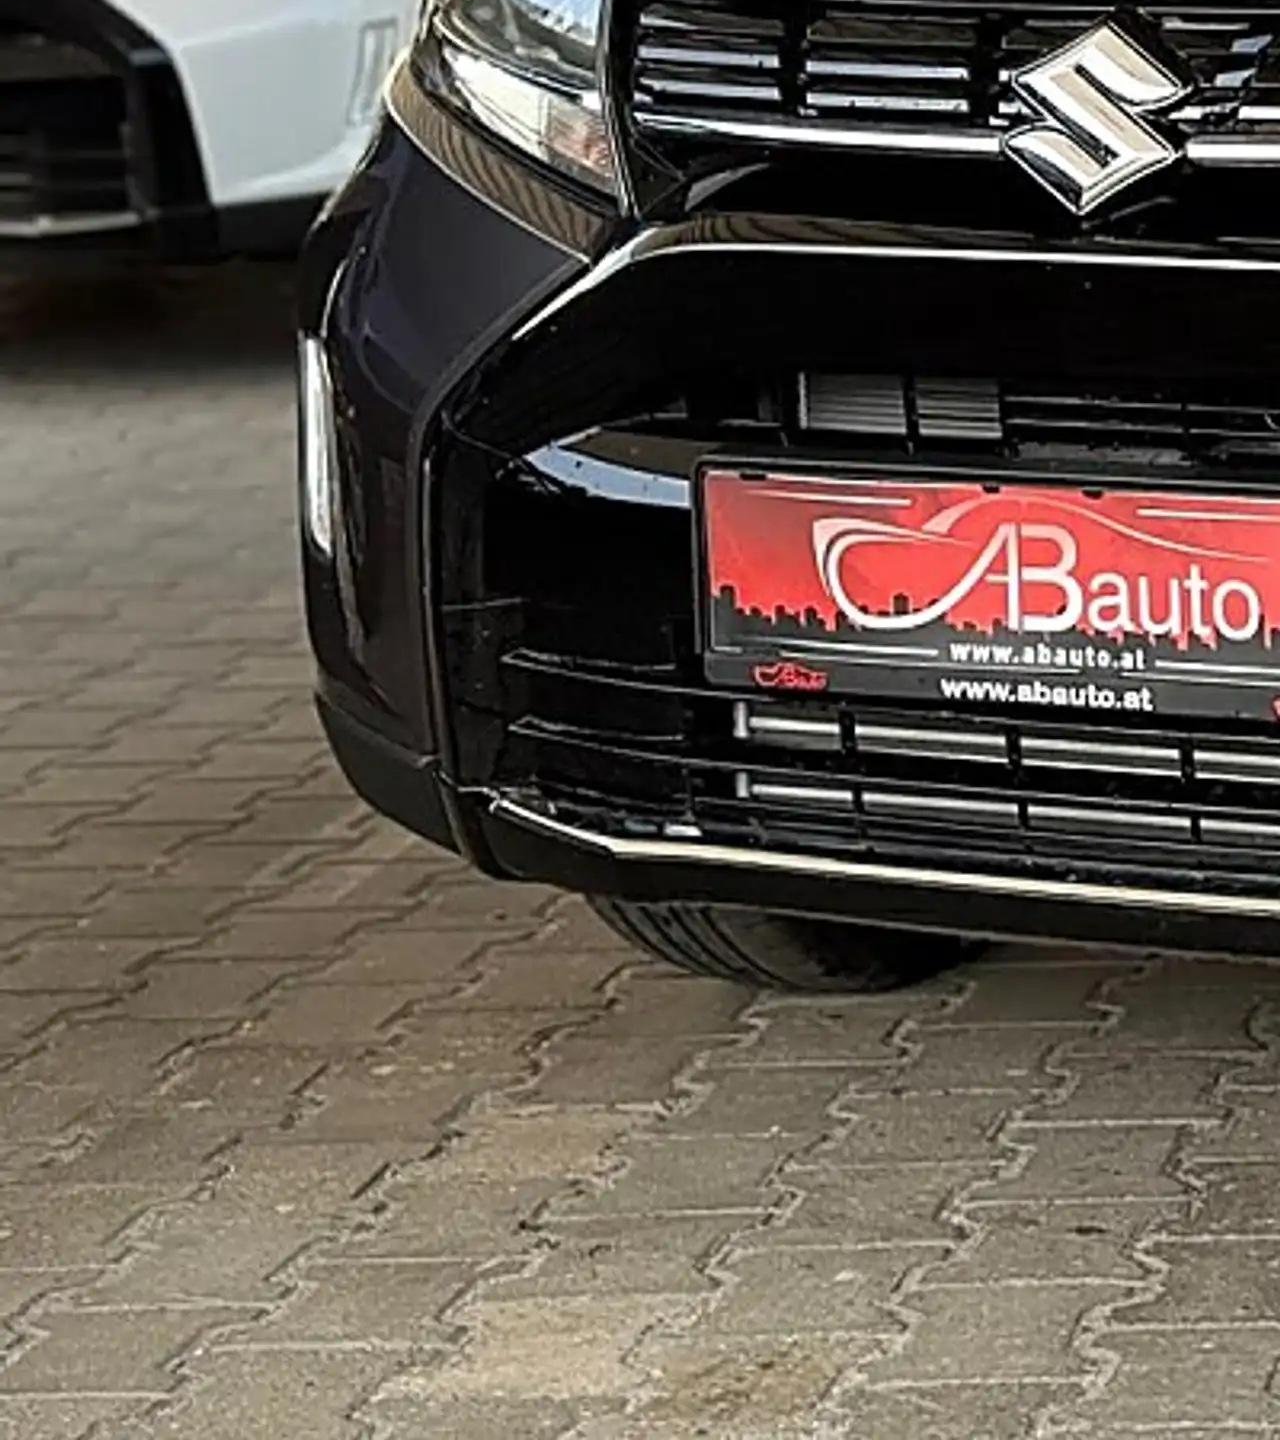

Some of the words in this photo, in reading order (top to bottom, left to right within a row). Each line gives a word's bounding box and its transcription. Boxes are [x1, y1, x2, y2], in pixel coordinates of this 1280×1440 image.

[952, 521, 1262, 641] ABauto
[949, 641, 1147, 670] www.abauto.at
[939, 677, 1154, 712] www.abauto.at
